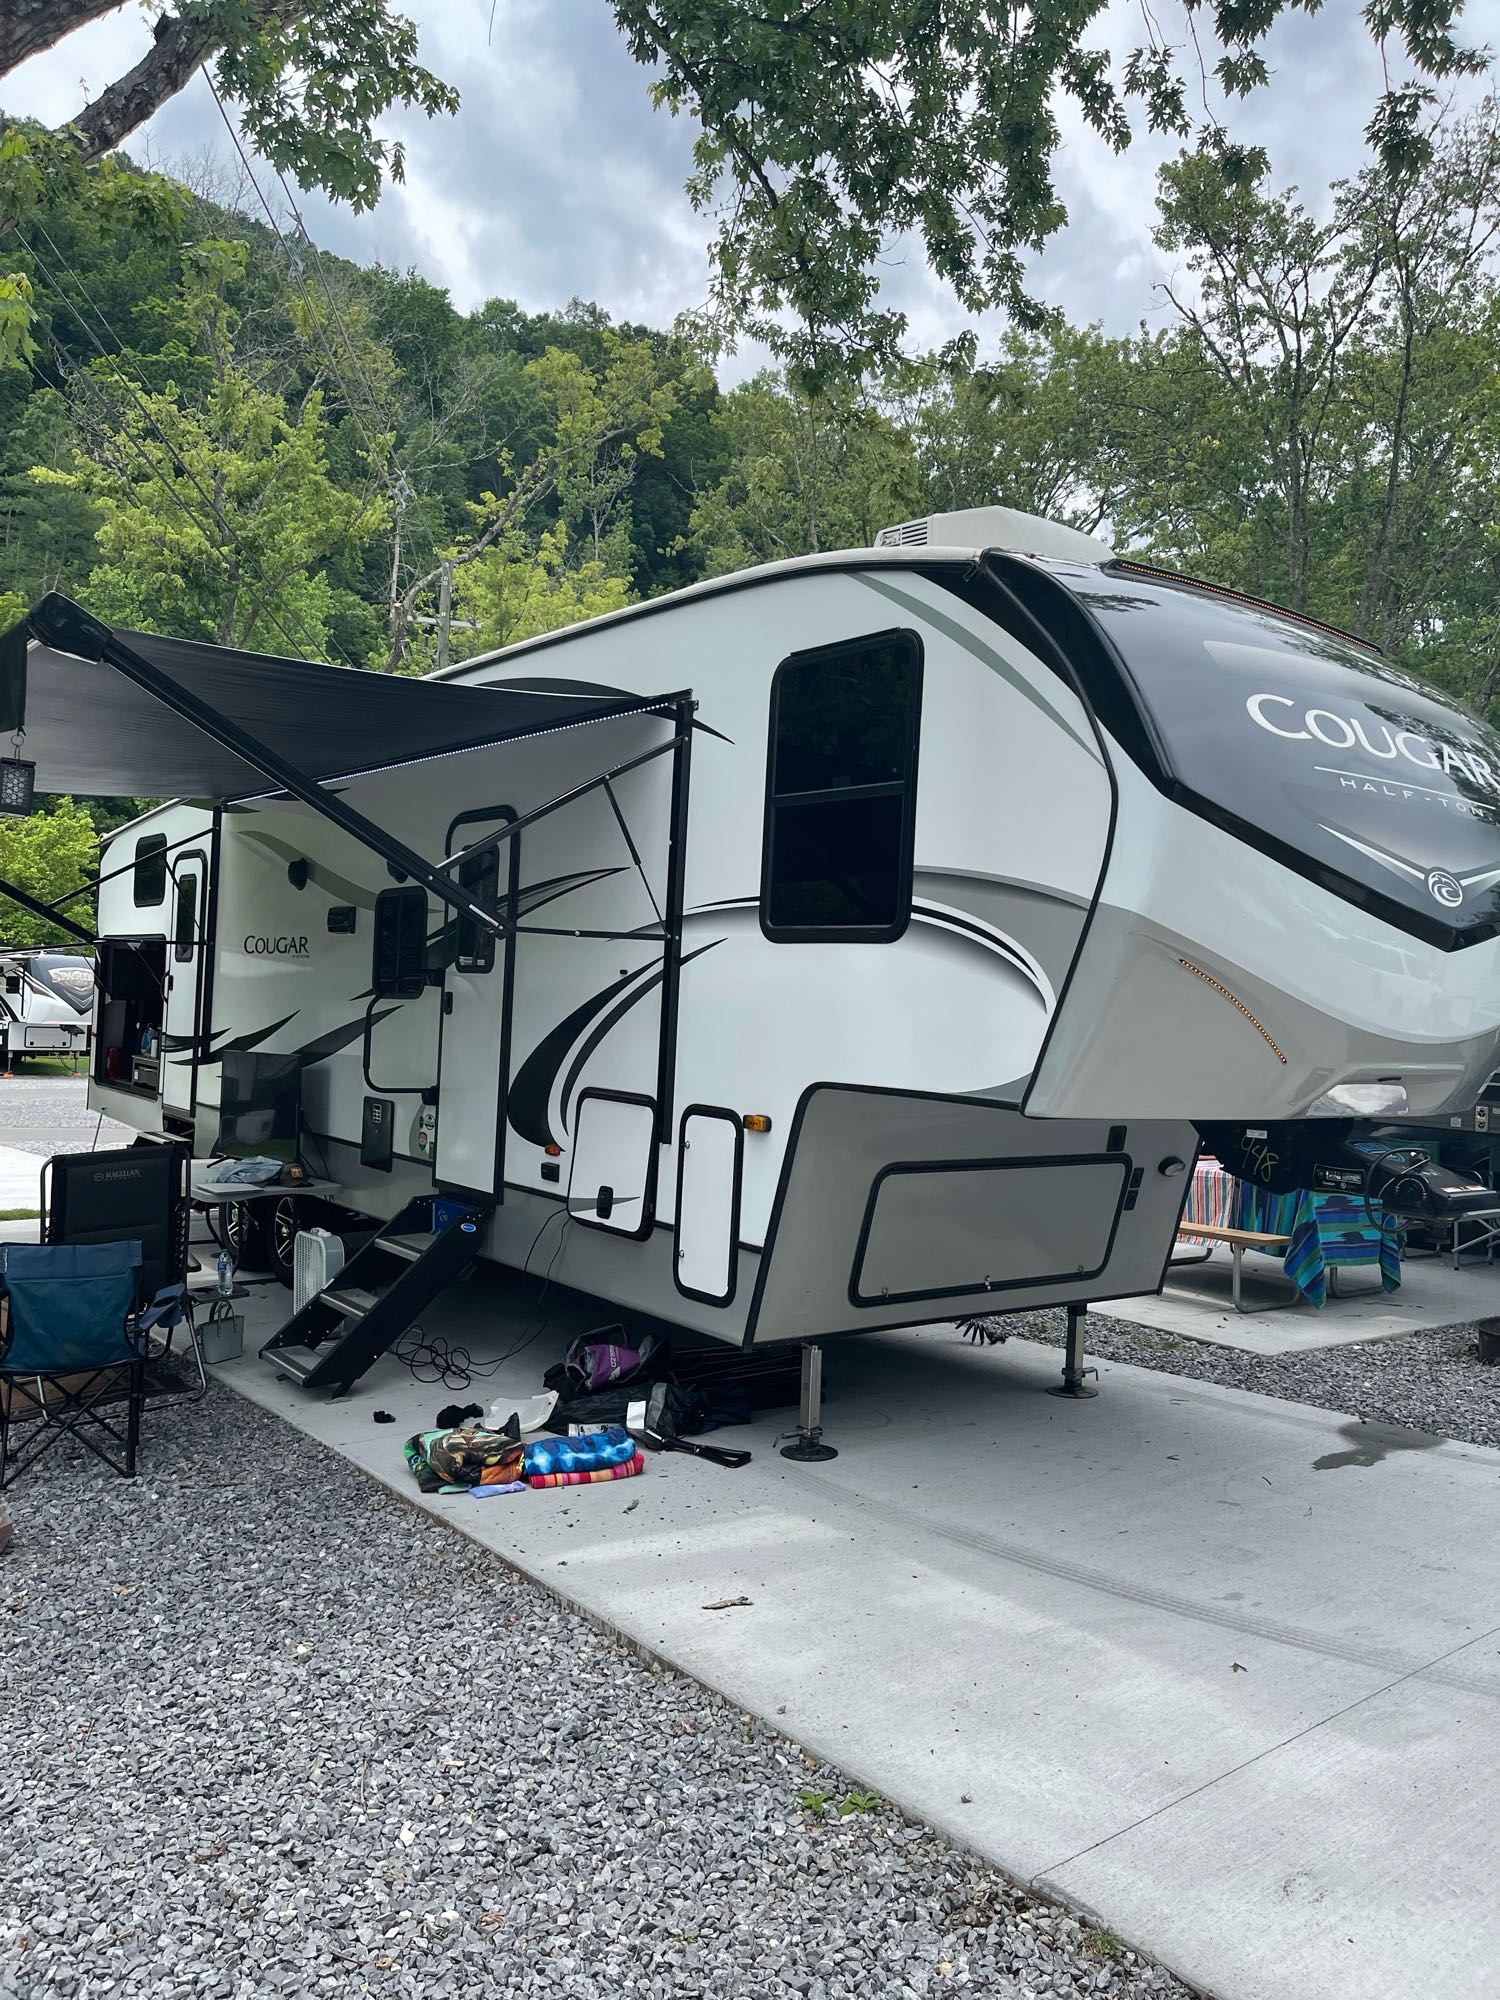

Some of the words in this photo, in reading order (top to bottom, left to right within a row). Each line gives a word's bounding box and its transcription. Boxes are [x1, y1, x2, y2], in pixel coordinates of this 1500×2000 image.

[1246, 693, 1500, 790] COUGAR
[1339, 776, 1485, 818] HALF-TON
[243, 934, 310, 955] COUGAR
[105, 1168, 141, 1178] MAGELLAN
